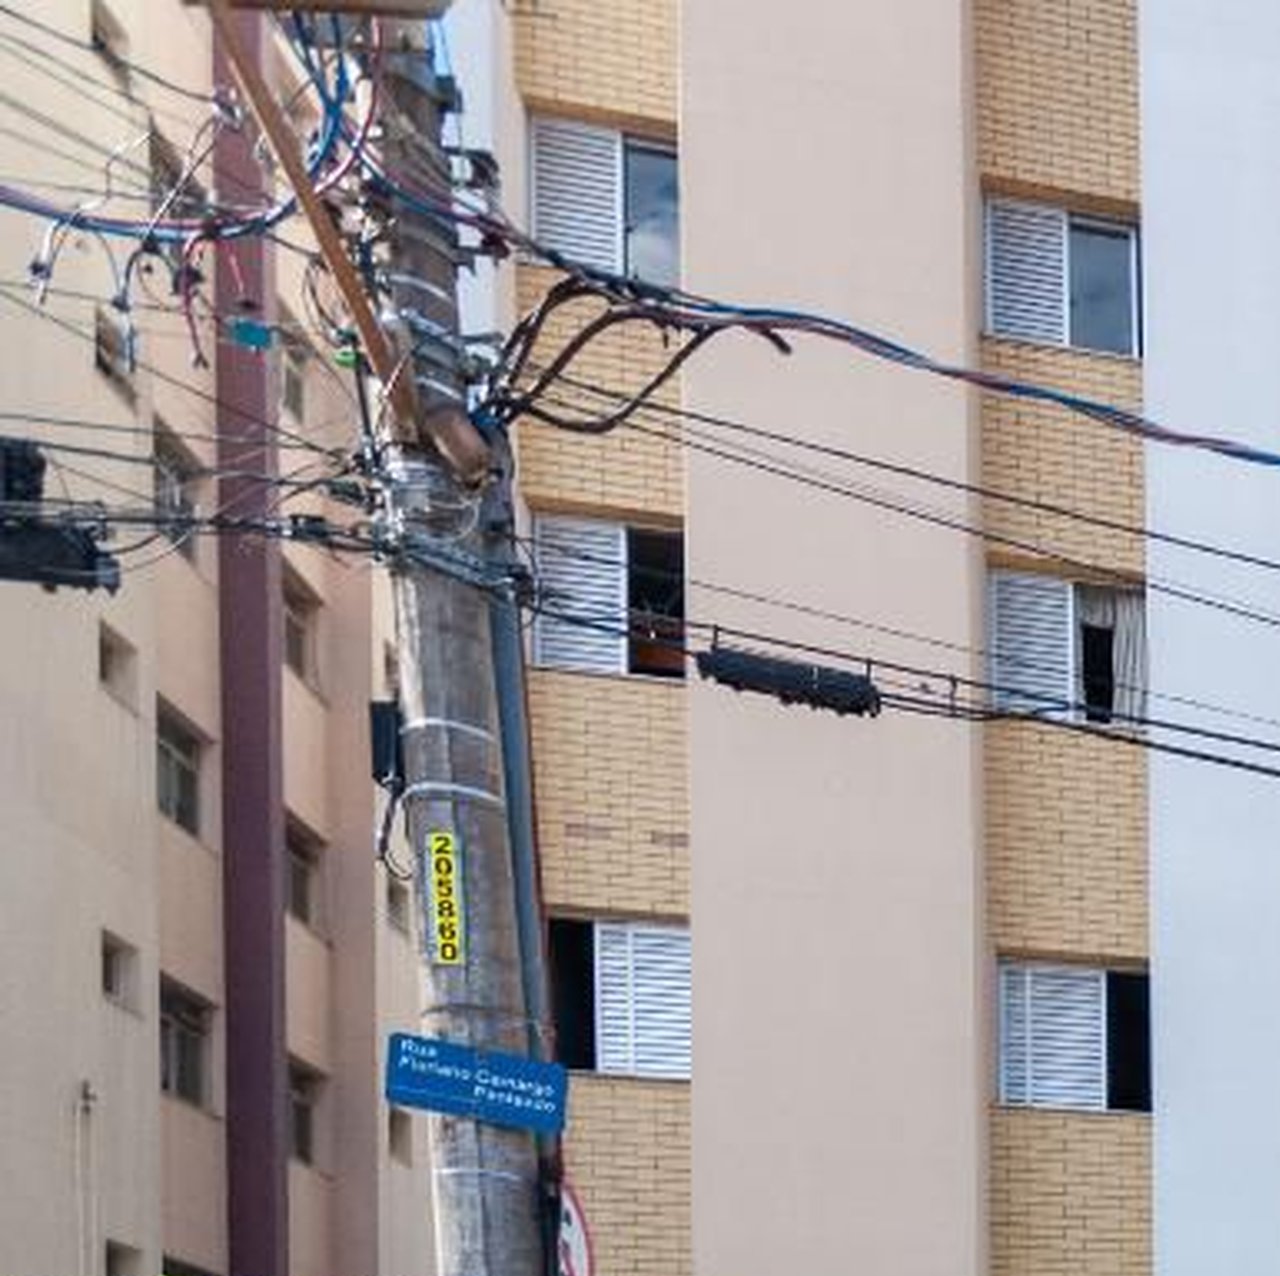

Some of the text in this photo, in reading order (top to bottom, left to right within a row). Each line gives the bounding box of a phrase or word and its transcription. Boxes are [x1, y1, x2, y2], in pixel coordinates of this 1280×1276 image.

[434, 836, 457, 960] 205860
[401, 1039, 438, 1057] Rua
[475, 1069, 555, 1097] Camargo
